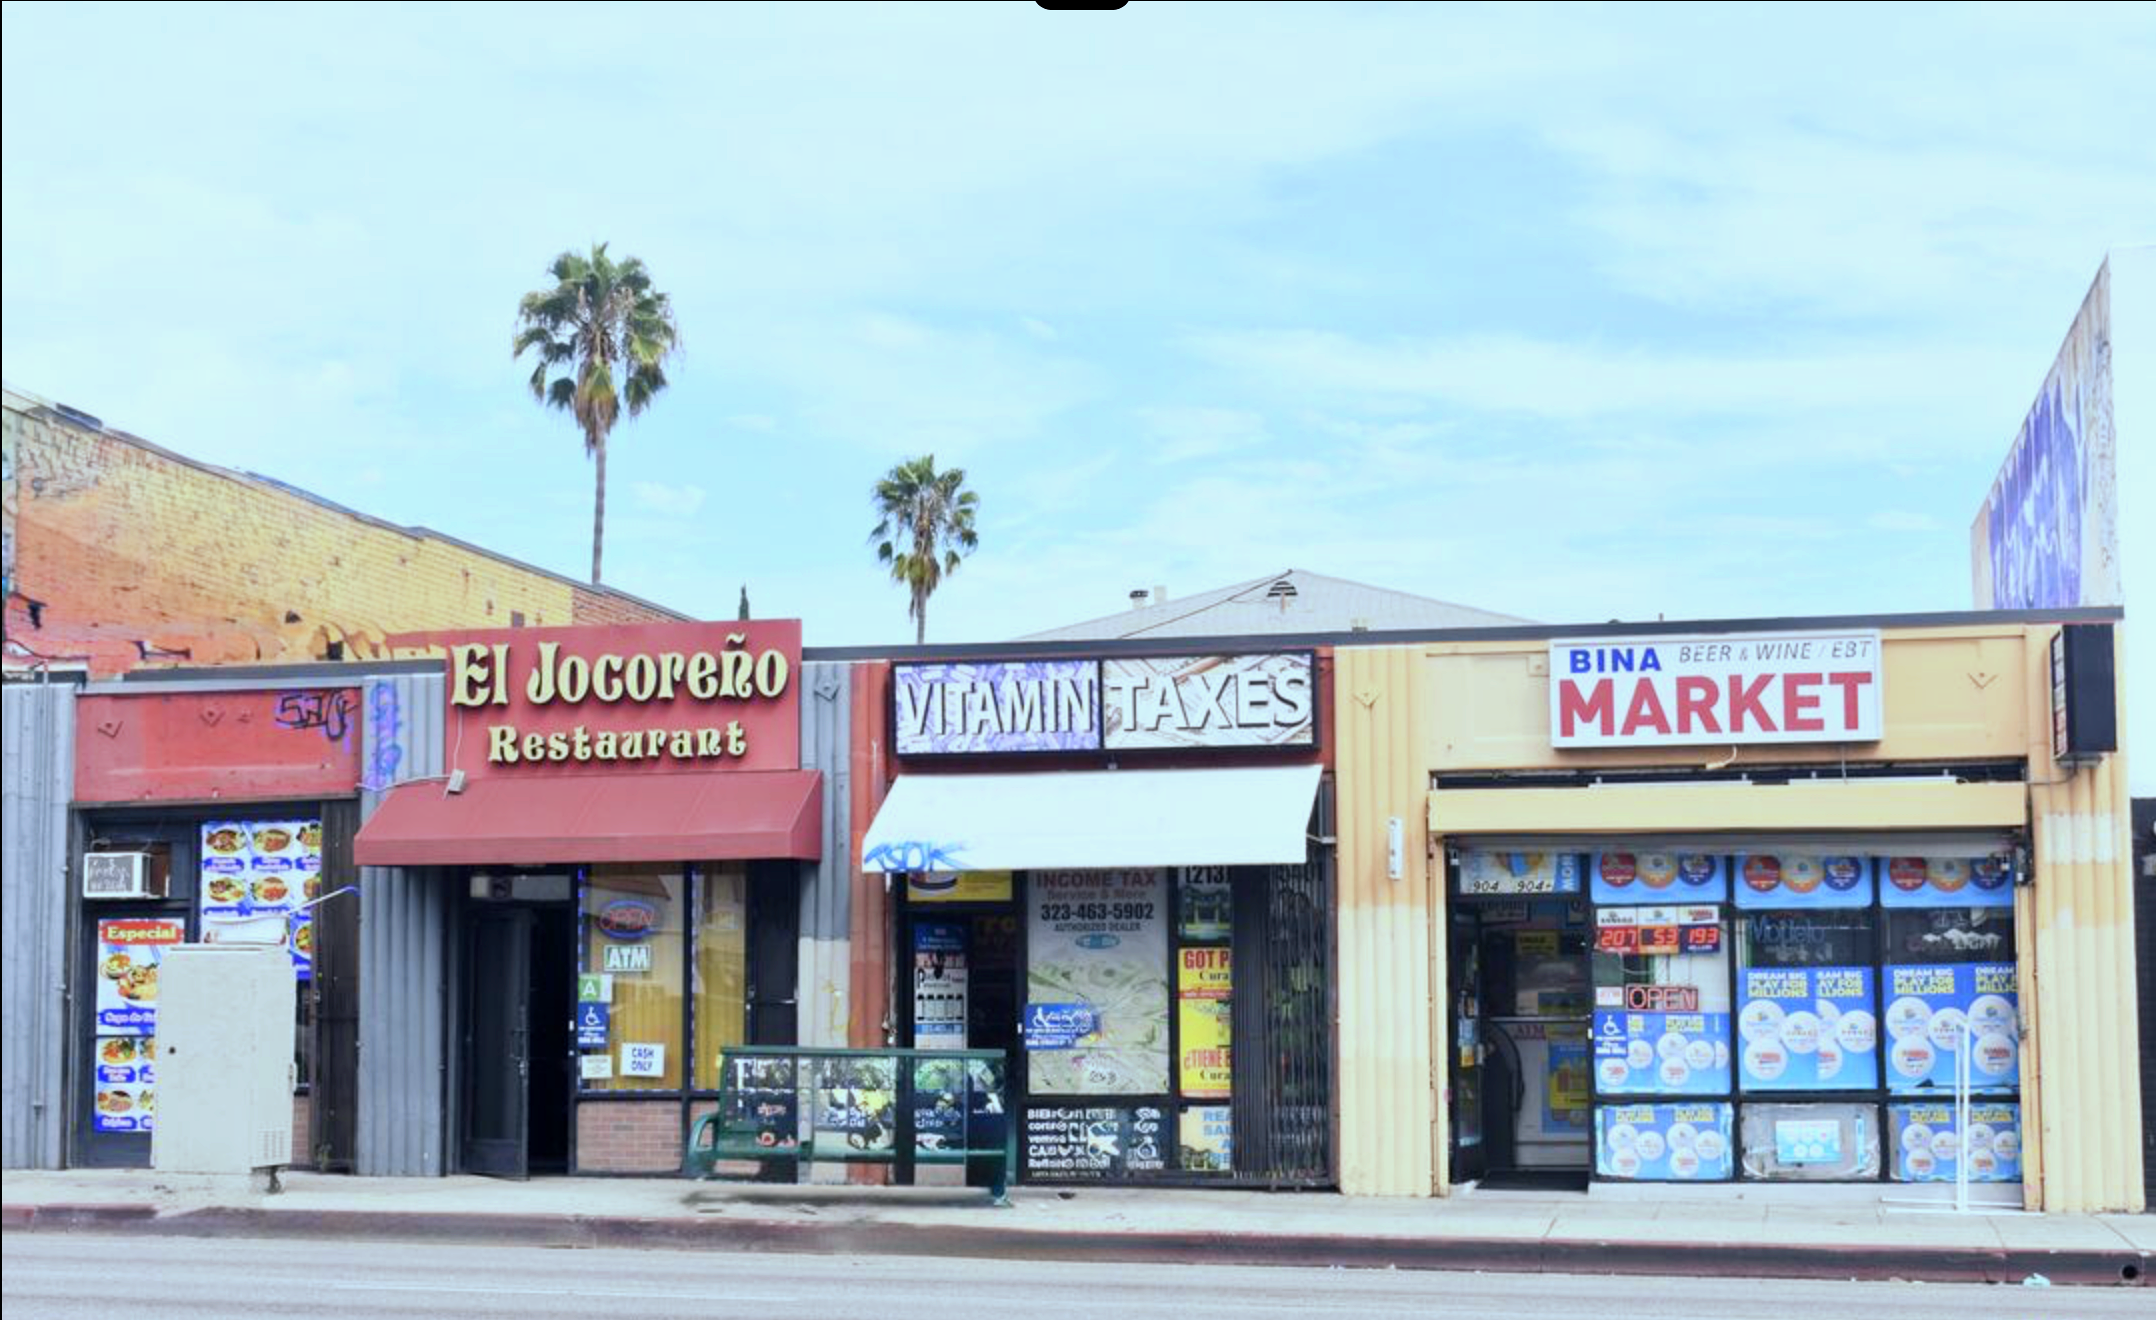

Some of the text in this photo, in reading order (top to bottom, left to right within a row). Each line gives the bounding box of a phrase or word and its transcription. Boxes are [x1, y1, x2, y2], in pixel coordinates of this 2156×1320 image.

[1570, 648, 1662, 673] BINA
[1680, 644, 1732, 663] BEER
[1756, 642, 1811, 661] WINE
[1832, 641, 1872, 658] EBT
[451, 633, 788, 706] El Jocoreño
[900, 667, 1309, 735] VITAMIN TAXES
[1559, 672, 1873, 737] MARKET
[488, 721, 747, 763] Restaurant
[1036, 870, 1157, 888] INCOME TAX
[1041, 903, 1154, 921] 323-463-5902
[107, 927, 177, 941] Especial
[1601, 930, 1636, 946] 207
[1654, 929, 1678, 945] 53
[1689, 928, 1718, 944] 193
[609, 948, 648, 969] ATM
[1184, 951, 1214, 969] GOT
[582, 980, 597, 996] A
[1629, 988, 1696, 1010] OPEN
